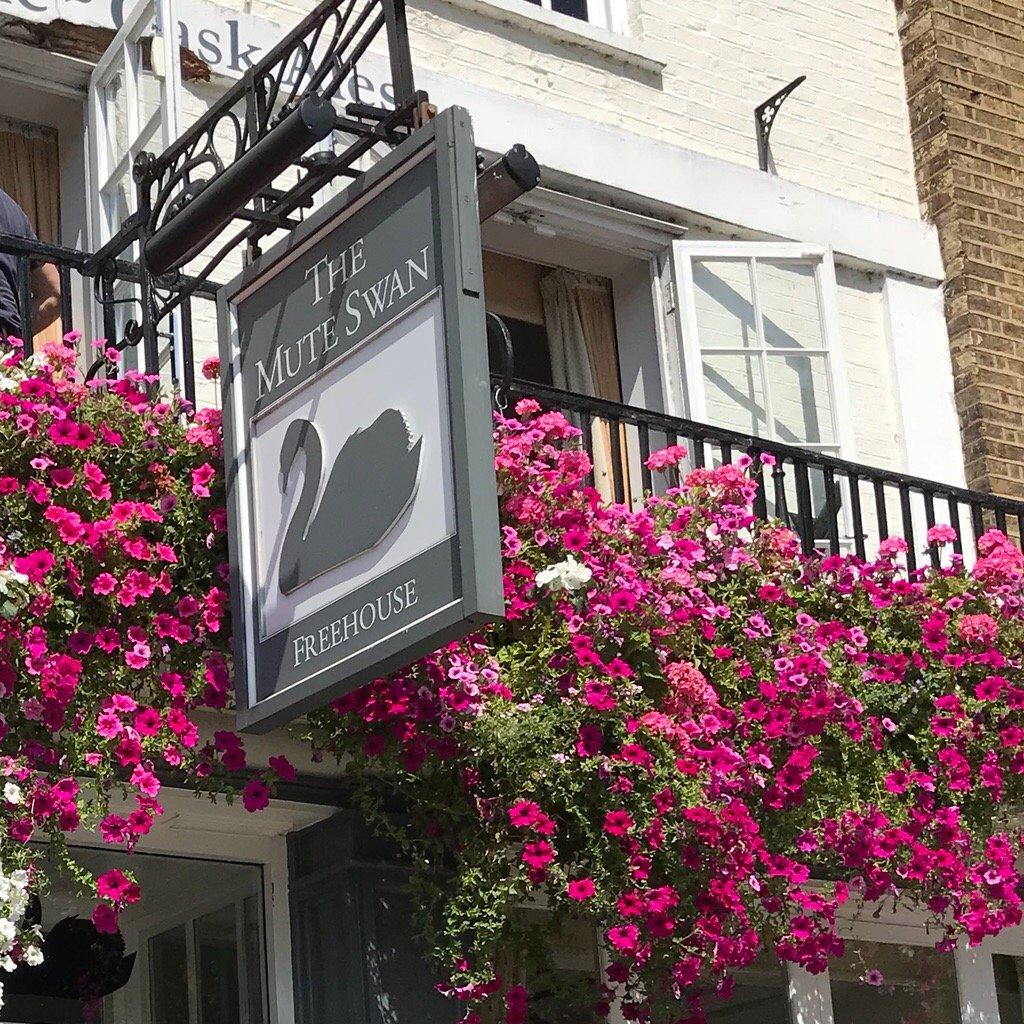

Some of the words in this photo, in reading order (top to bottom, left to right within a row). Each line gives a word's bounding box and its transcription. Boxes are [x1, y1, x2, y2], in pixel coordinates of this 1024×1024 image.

[304, 238, 367, 307] THE
[255, 315, 339, 402] MUTE
[345, 245, 432, 337] SWAN
[292, 578, 419, 667] FREEHOUSE
